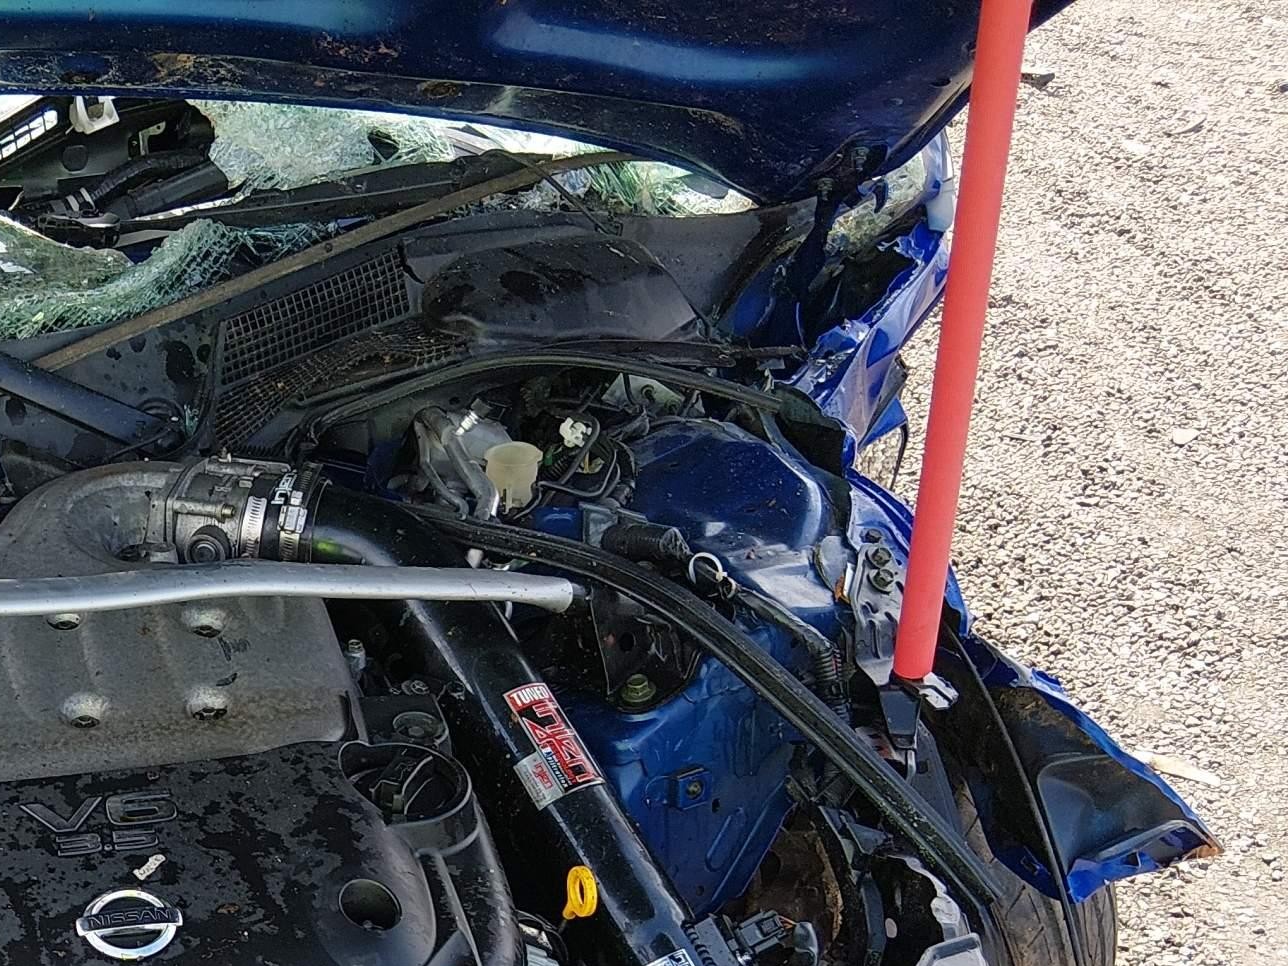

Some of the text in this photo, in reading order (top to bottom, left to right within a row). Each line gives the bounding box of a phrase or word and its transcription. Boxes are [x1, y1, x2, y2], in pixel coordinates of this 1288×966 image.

[510, 685, 550, 707] TUNED
[521, 699, 596, 783] injen
[19, 789, 178, 833] V6
[55, 829, 159, 857] 3.5
[89, 907, 172, 928] NISSAN
